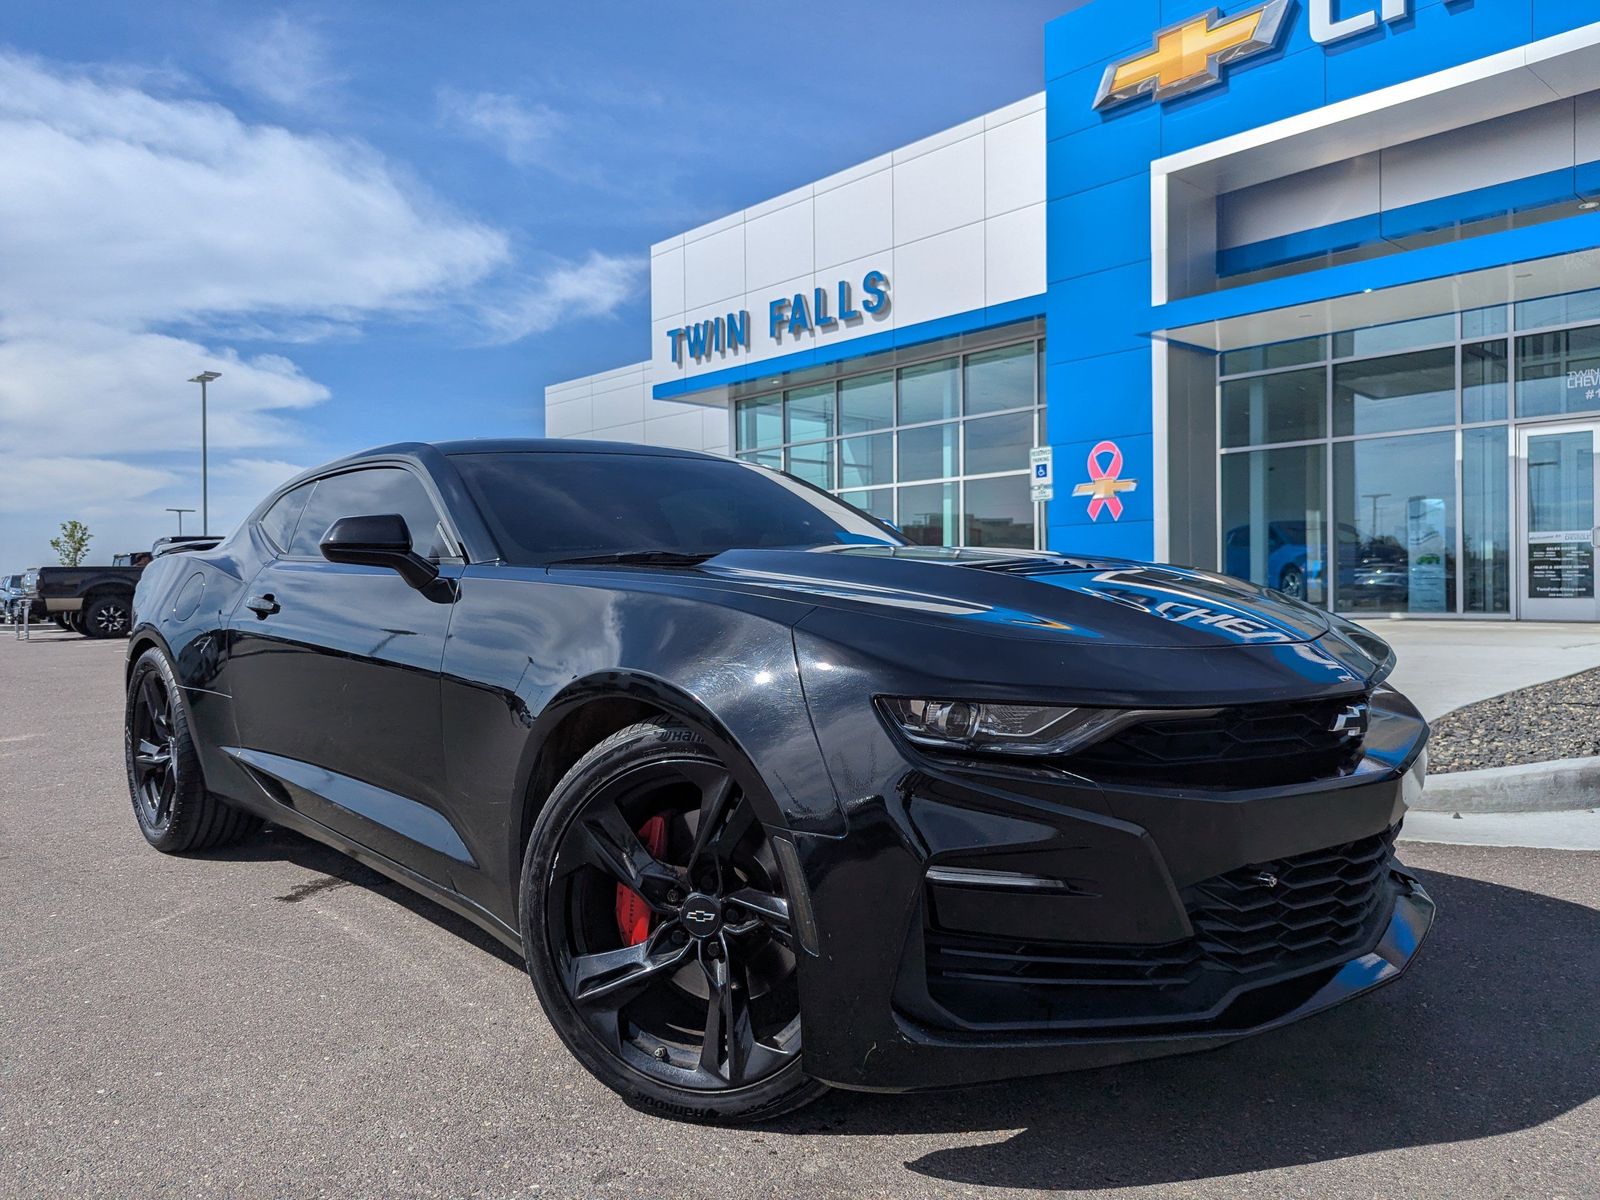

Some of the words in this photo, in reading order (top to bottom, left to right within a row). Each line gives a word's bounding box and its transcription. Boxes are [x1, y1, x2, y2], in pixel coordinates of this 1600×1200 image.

[667, 310, 748, 365] TWIN
[769, 270, 889, 341] FALLS
[1567, 368, 1600, 378] TWIN
